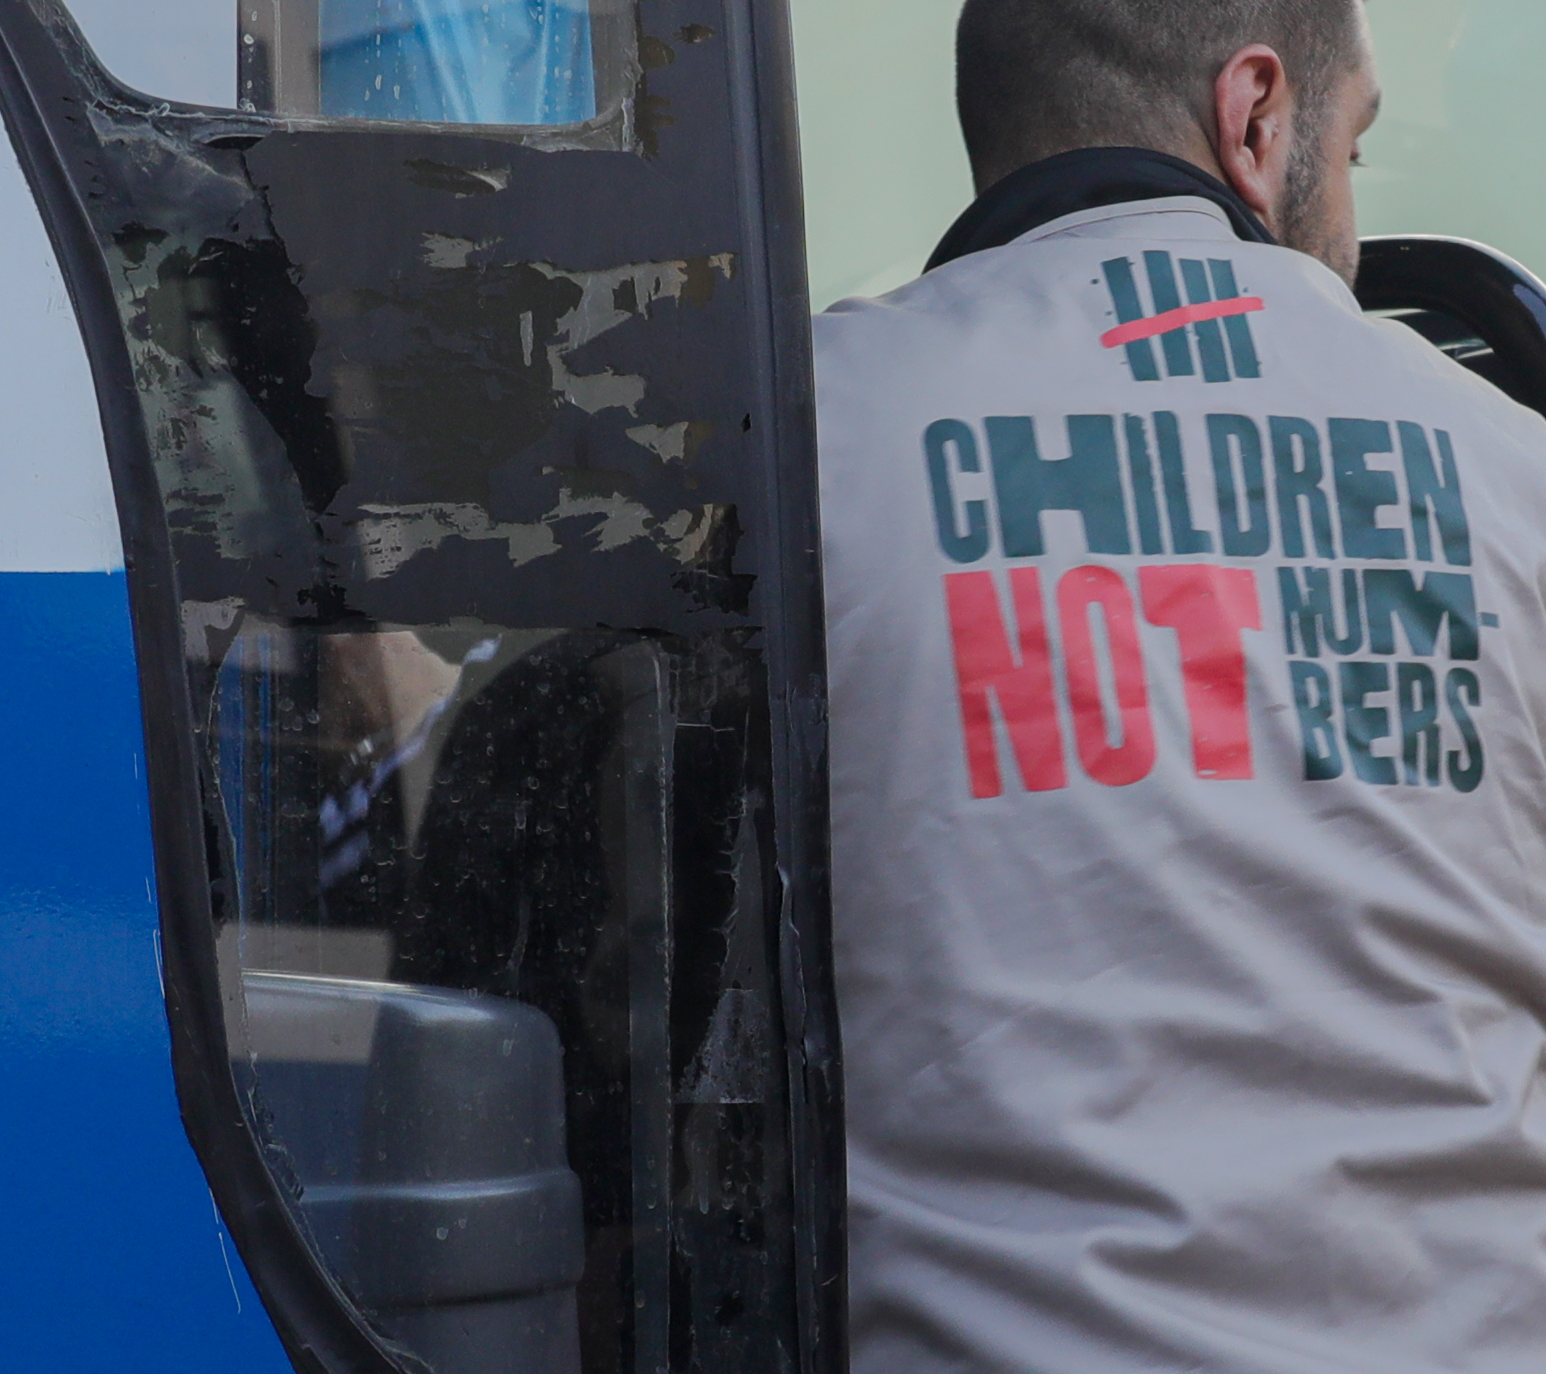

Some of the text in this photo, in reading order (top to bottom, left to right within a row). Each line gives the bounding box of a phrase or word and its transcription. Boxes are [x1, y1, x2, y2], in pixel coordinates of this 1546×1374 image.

[922, 410, 1472, 566] CHILDREN
[944, 564, 1264, 799] NOT
[1276, 566, 1500, 662] NUM-
[1288, 661, 1485, 794] BERS
